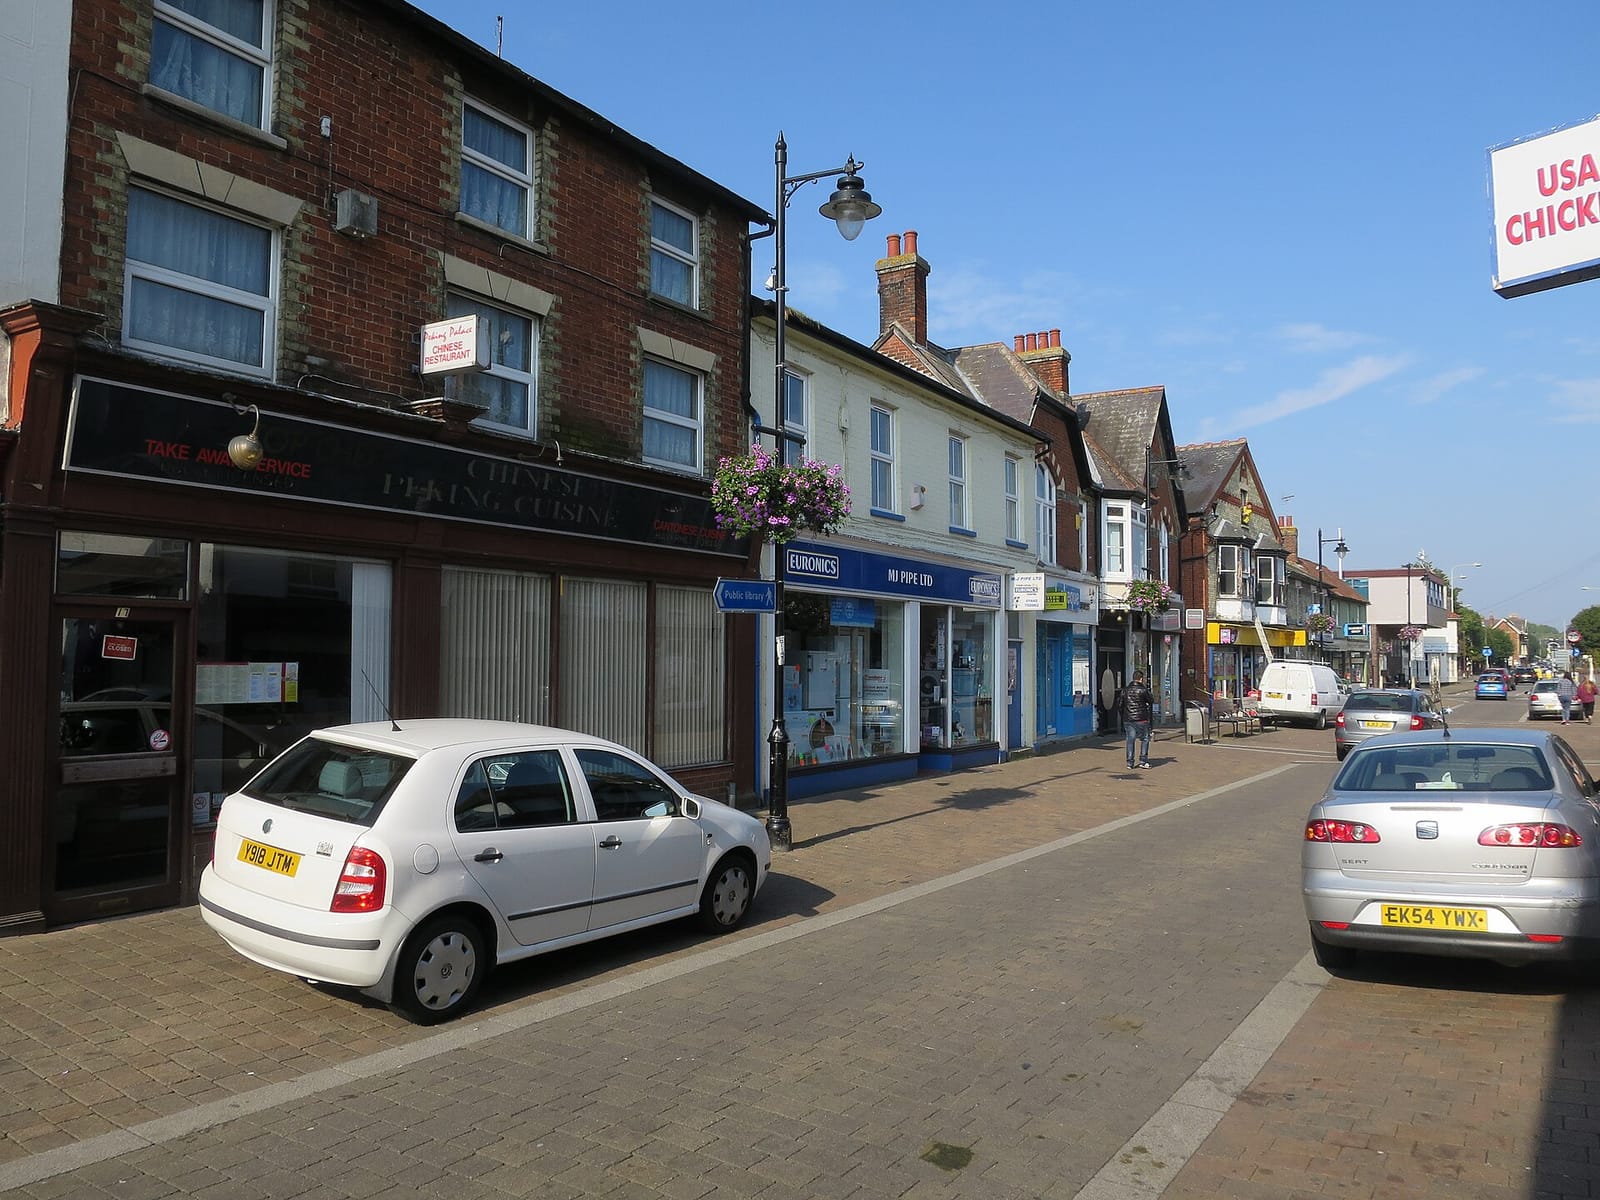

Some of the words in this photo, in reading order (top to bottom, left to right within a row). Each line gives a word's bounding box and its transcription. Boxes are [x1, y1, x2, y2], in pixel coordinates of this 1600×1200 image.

[1537, 153, 1600, 197] USA
[1505, 192, 1600, 246] CHICK
[449, 325, 473, 338] Palace
[424, 349, 471, 366] RESTAURANT
[432, 341, 464, 355] CHINESE
[145, 439, 191, 461] TAKE
[196, 448, 236, 467] AWA
[256, 458, 312, 479] ERVICE
[790, 554, 837, 575] EURONICS
[888, 568, 898, 583] MJ
[900, 571, 918, 586] PIPE
[919, 573, 933, 587] LTD
[724, 590, 743, 601] Public
[744, 590, 765, 602] library
[107, 644, 132, 652] CLOSED
[245, 843, 267, 864] Y918
[267, 851, 293, 873] JTM
[1386, 907, 1435, 925] EK54
[1442, 909, 1478, 927] YWX
